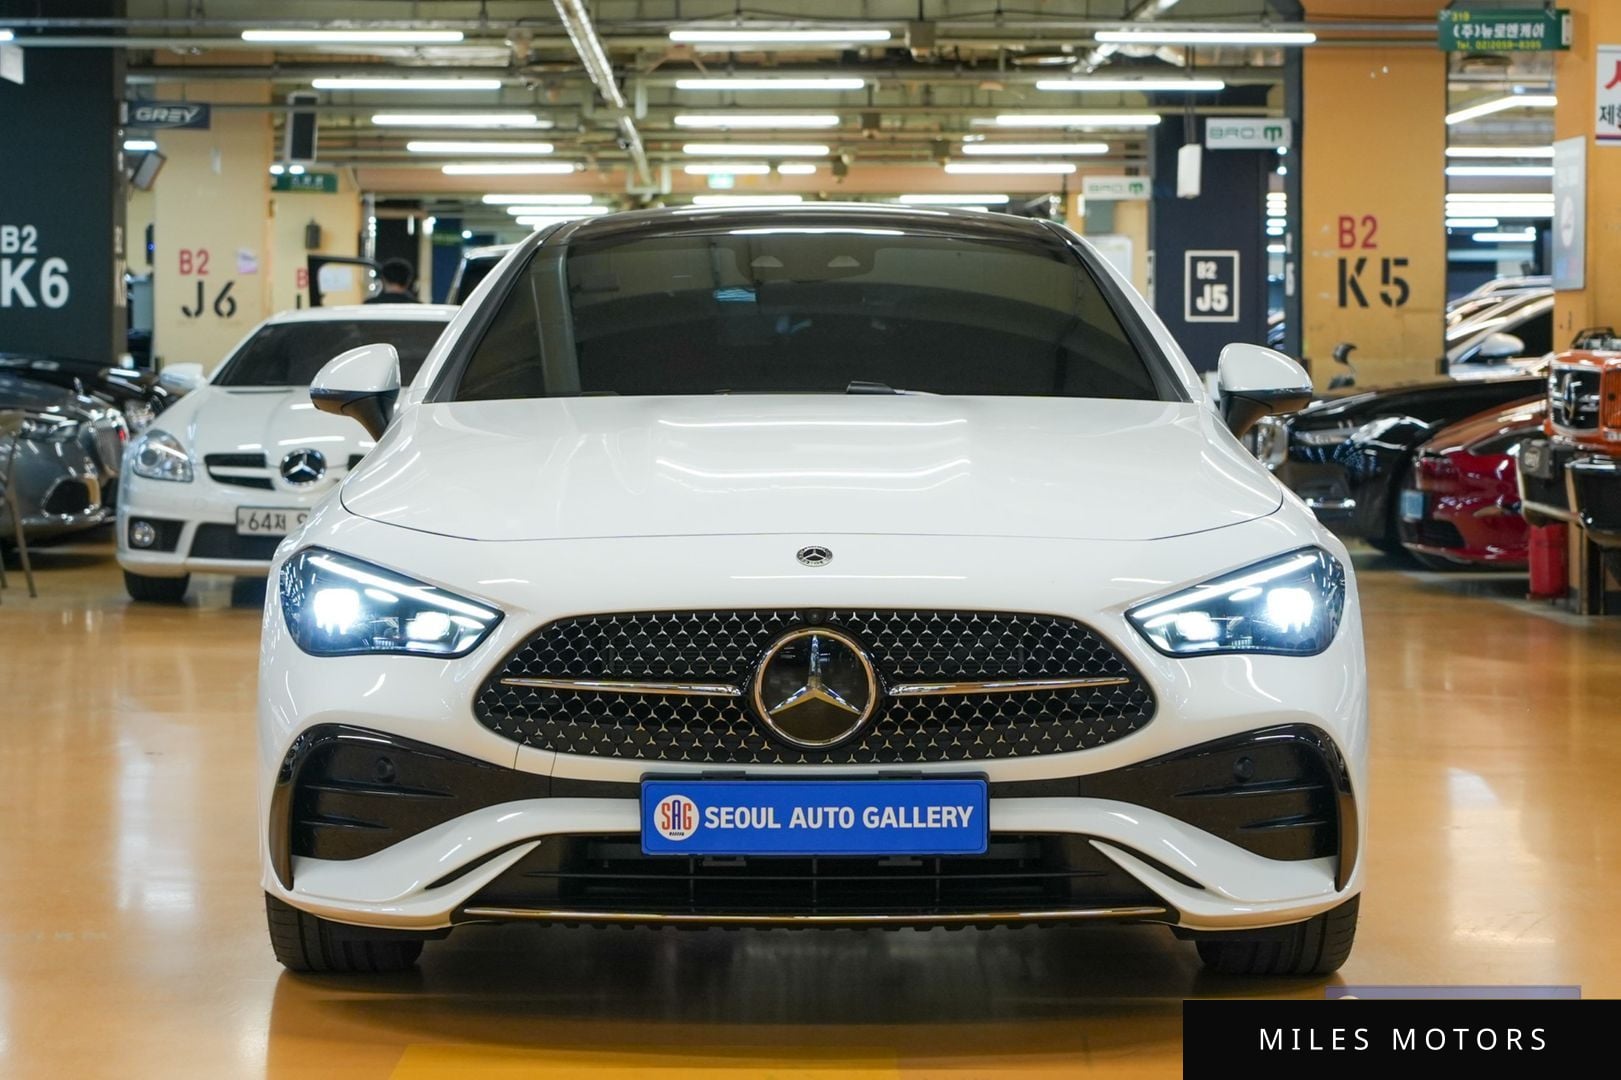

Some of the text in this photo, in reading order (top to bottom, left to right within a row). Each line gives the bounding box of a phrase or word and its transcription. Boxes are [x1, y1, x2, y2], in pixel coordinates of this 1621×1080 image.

[136, 106, 199, 123] GREY
[0, 224, 38, 254] B2
[1339, 215, 1378, 250] B2
[179, 249, 210, 275] B2
[1196, 260, 1218, 280] B2
[0, 257, 69, 309] K6
[1196, 283, 1229, 312] J5
[1338, 257, 1410, 308] K5
[182, 281, 237, 318] J6
[661, 800, 693, 830] SAG
[704, 806, 974, 829] SEOUL AUTO GALLERY
